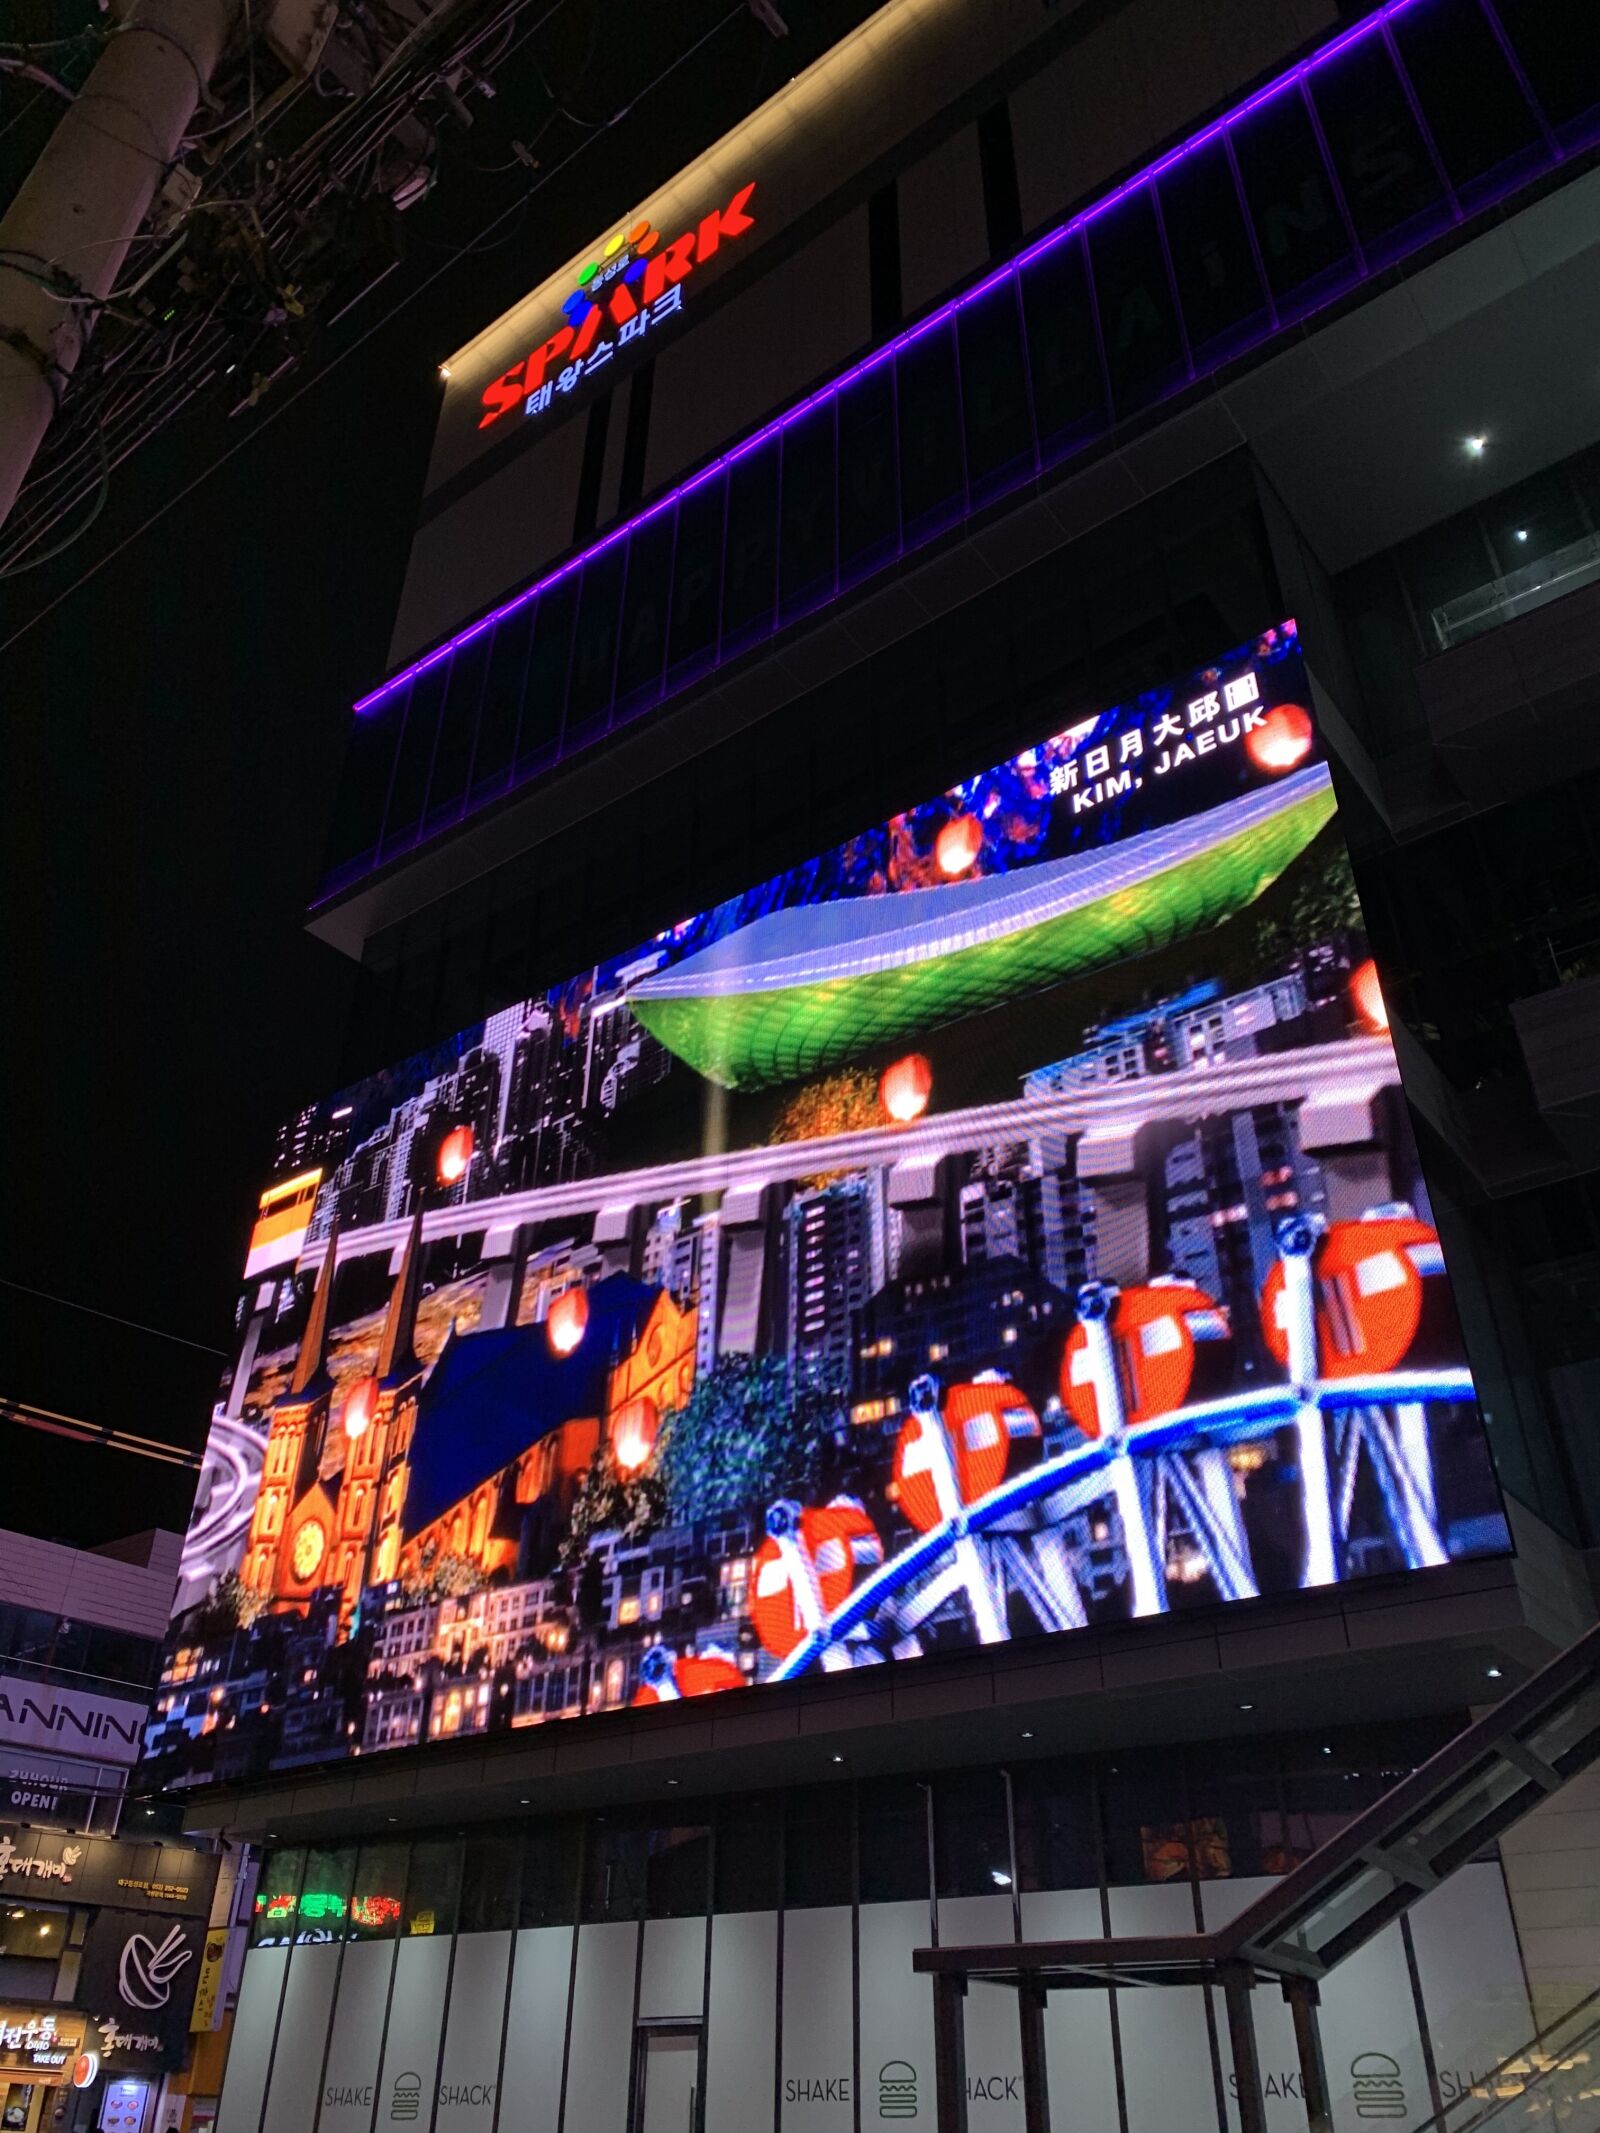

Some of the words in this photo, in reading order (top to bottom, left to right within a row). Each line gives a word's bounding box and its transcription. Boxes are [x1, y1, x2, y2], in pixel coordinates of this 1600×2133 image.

[478, 181, 756, 429] SPARK
[525, 283, 683, 415] 태왕스파크
[1073, 769, 1143, 814] KIM,
[1154, 706, 1268, 774] JAEUK
[0, 1693, 146, 1746] ANNIN
[33, 2053, 50, 2064] TAKE
[51, 2054, 66, 2065] OUT
[325, 2086, 373, 2106] SHAKE
[438, 2085, 492, 2106] SHACK
[785, 2078, 849, 2102] SHAKE
